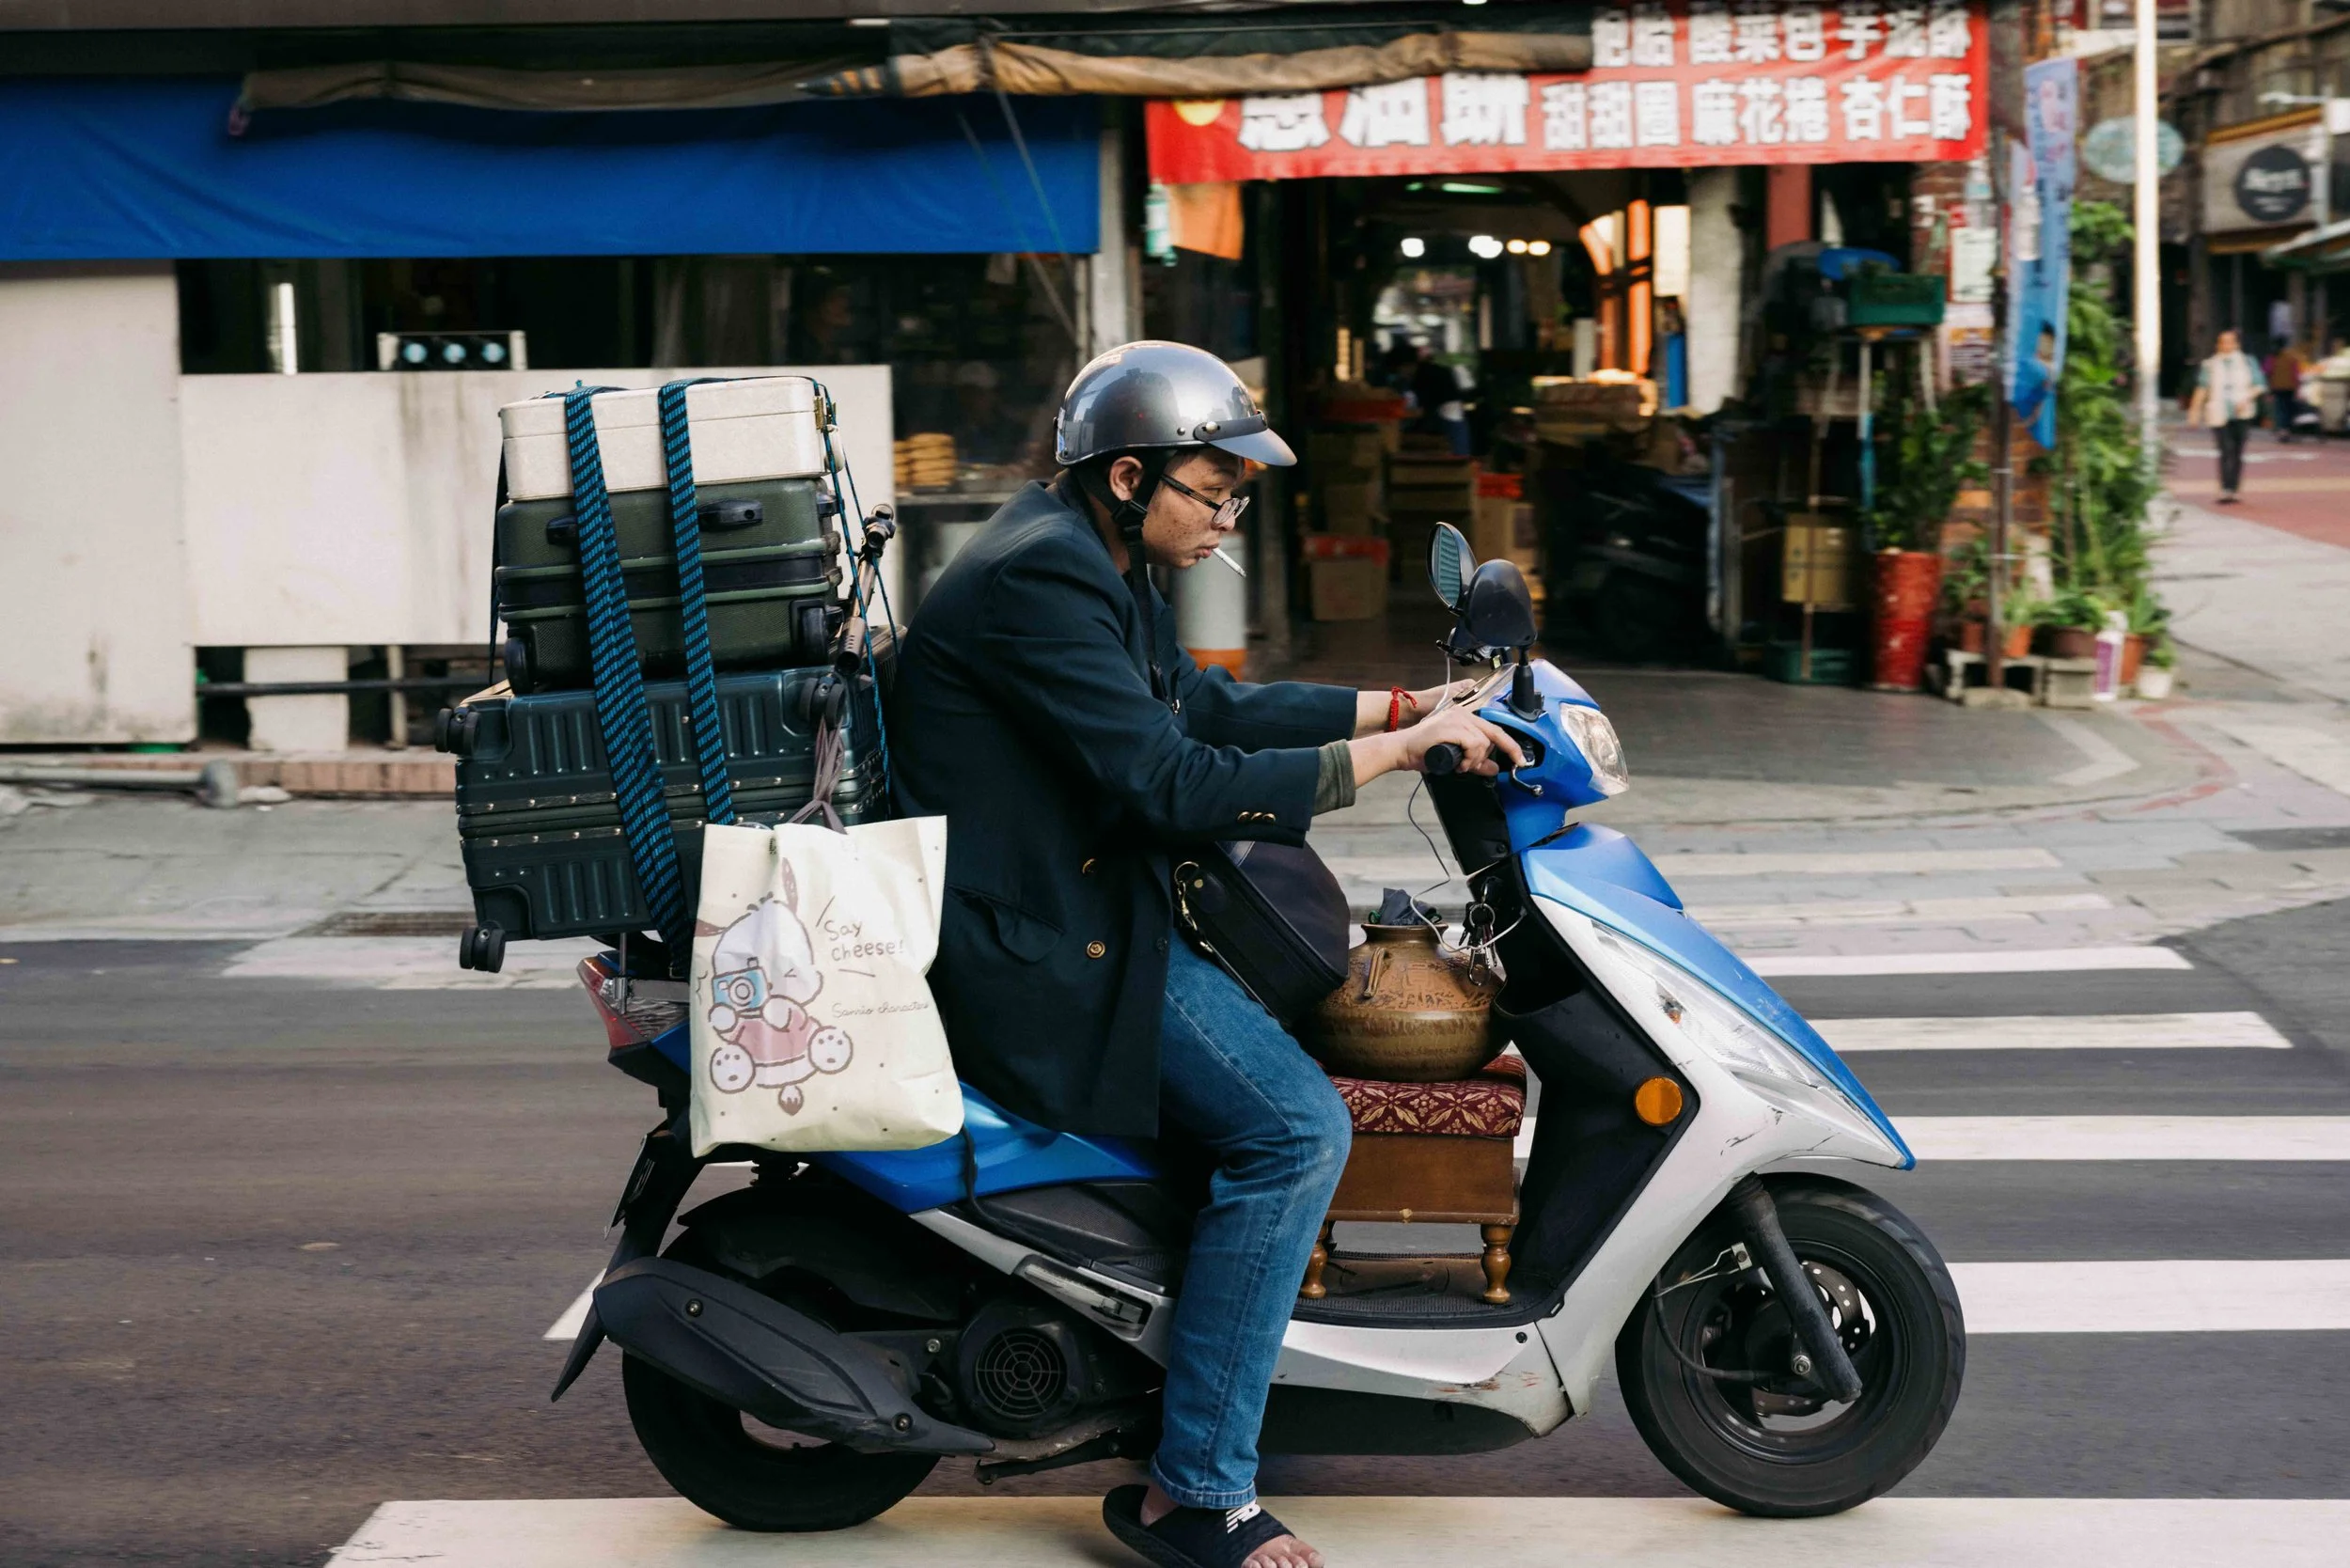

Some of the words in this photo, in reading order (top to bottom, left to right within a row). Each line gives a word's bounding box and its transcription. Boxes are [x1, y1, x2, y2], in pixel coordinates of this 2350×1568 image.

[1541, 81, 1680, 150] 甜甜圈
[1840, 72, 1972, 140] 杏仁酥
[823, 920, 862, 941] Say
[831, 940, 903, 962] cheese!
